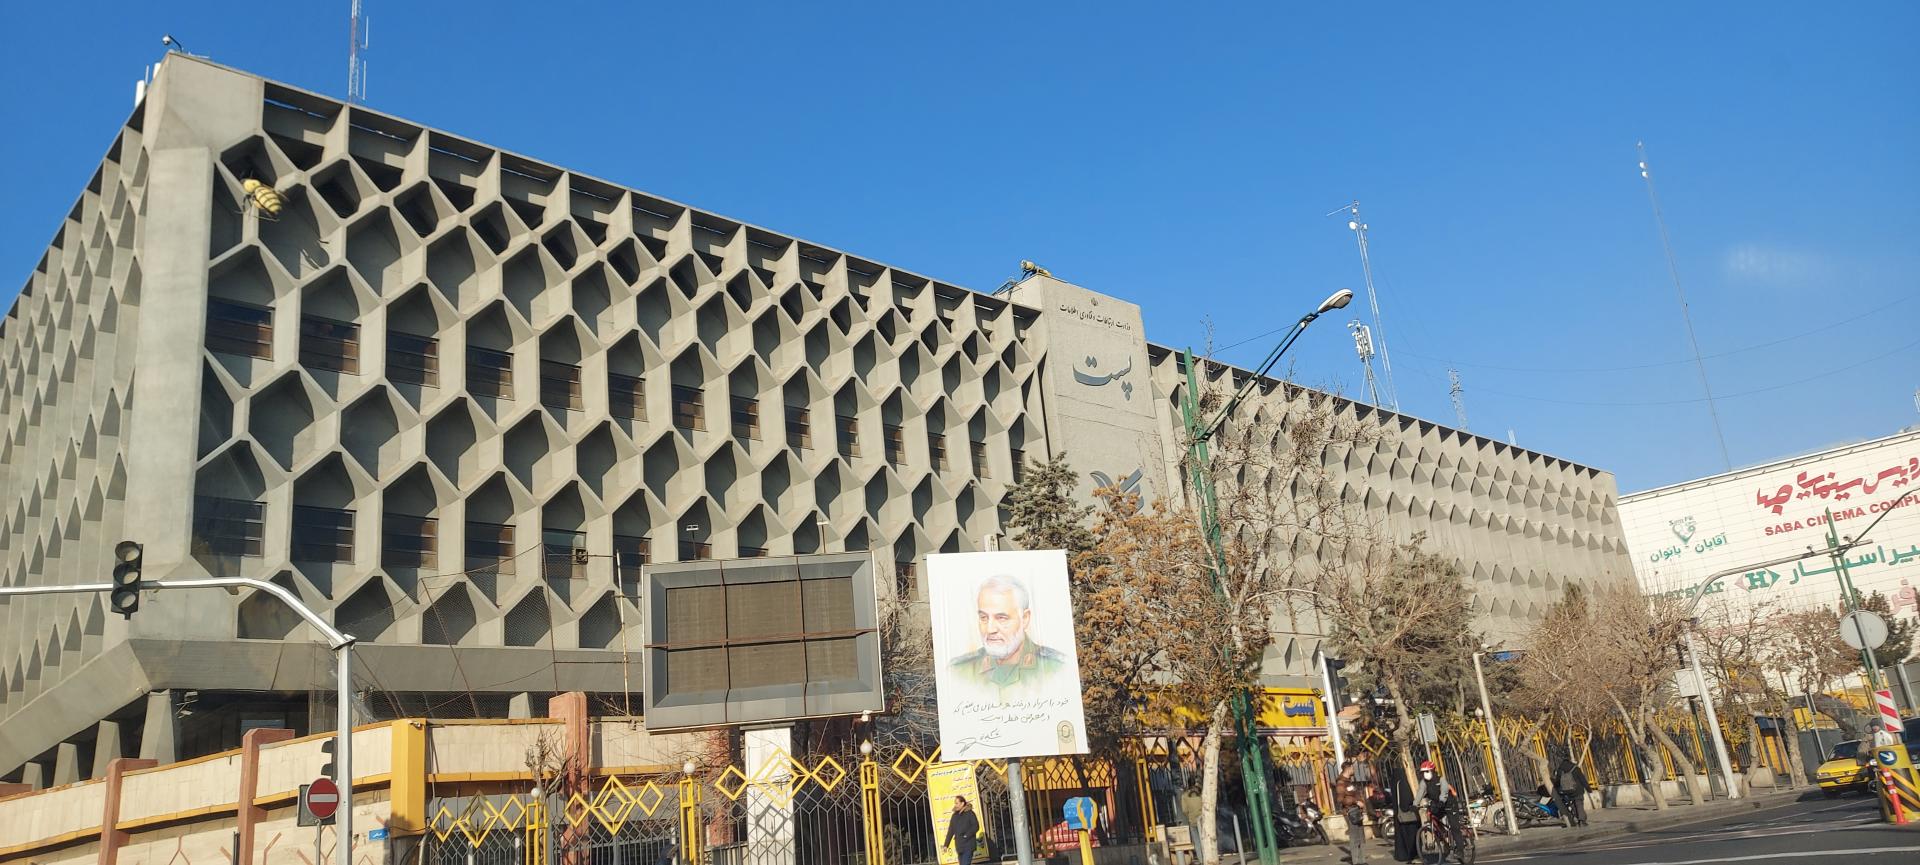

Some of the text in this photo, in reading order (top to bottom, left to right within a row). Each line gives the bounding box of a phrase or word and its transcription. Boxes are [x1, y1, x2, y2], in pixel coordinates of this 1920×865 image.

[1072, 353, 1133, 401] پست
[1796, 471, 1864, 502] سینمایی
[1756, 484, 1794, 516] صبا
[1765, 520, 1804, 536] SABA
[1650, 545, 1681, 563] بانوان
[1694, 532, 1728, 553] آقایان
[1745, 570, 1770, 591] H
[1281, 696, 1316, 727] پست
